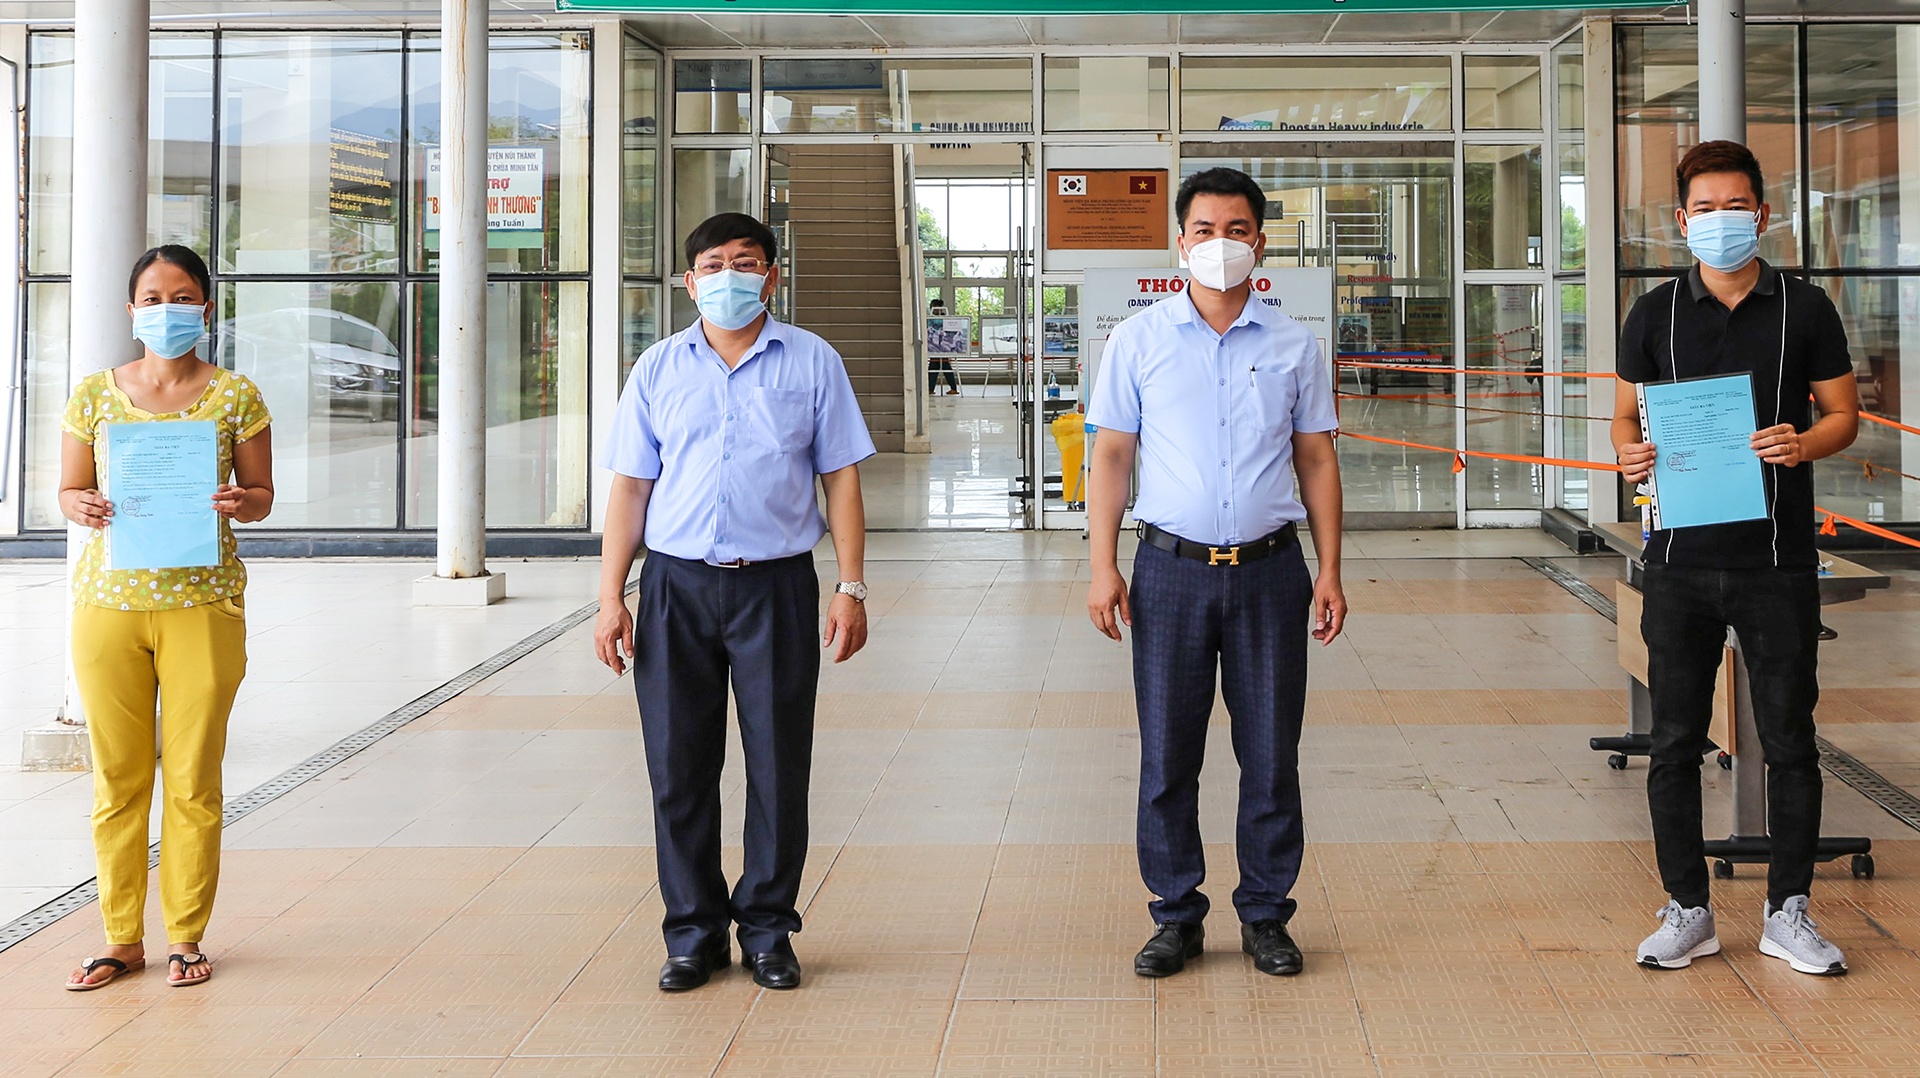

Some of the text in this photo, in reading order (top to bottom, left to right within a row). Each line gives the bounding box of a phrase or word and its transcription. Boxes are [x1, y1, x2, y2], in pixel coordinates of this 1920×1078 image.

[488, 151, 504, 160] UYỆN
[1365, 252, 1397, 262] Friendly
[1138, 275, 1190, 292] THÔ
